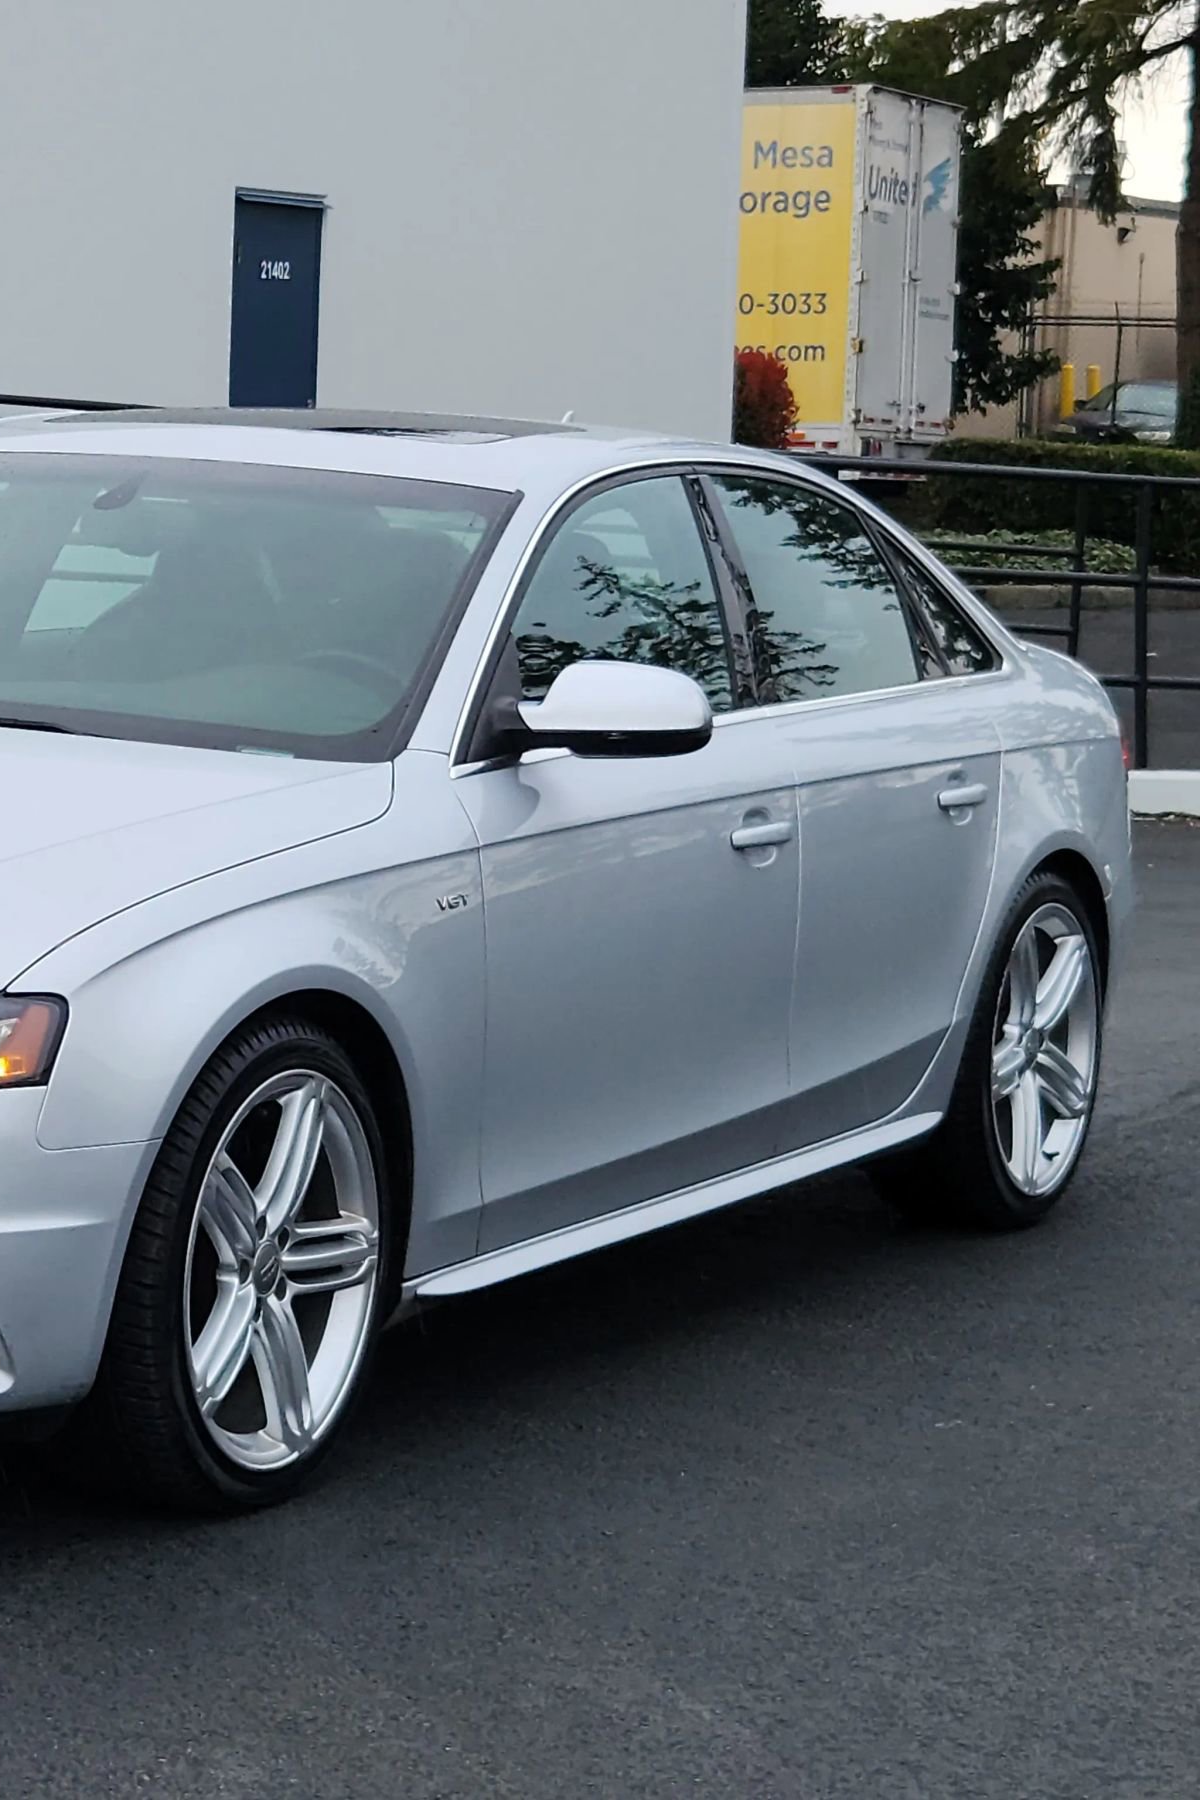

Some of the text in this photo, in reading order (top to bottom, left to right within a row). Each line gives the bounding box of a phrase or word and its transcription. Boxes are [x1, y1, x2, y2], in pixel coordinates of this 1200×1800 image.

[753, 140, 833, 169] Mesa
[739, 190, 831, 219] orage
[260, 260, 290, 280] 21402
[739, 293, 827, 315] 0-3033
